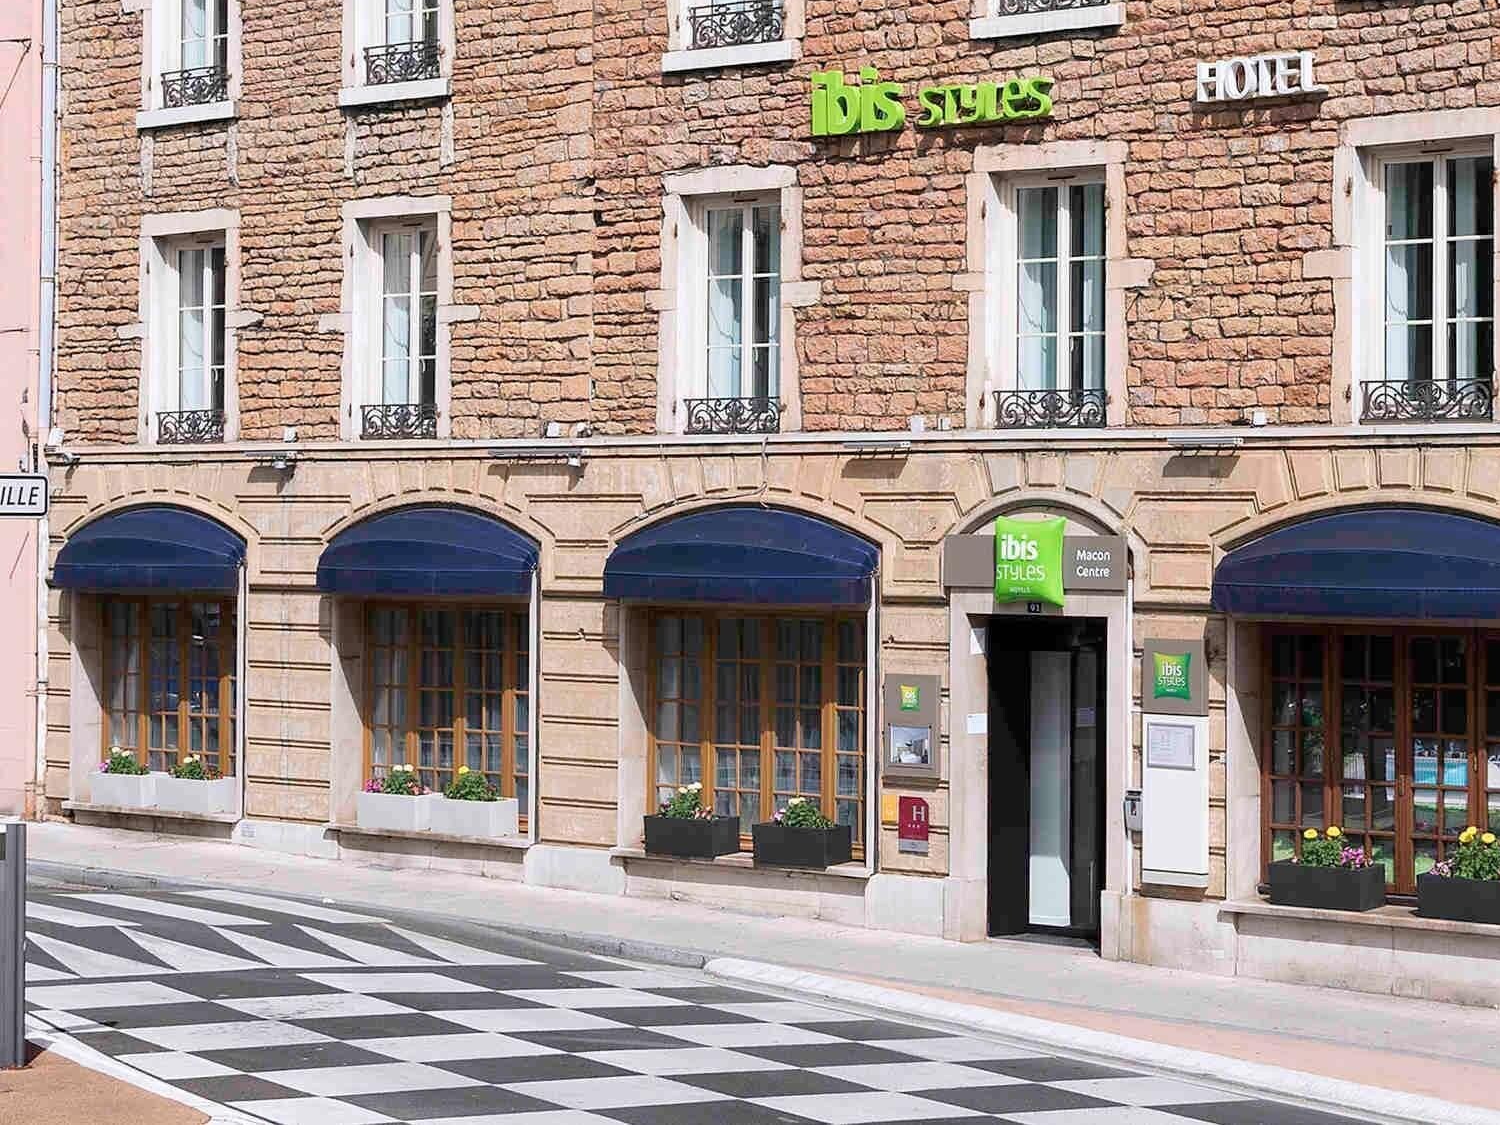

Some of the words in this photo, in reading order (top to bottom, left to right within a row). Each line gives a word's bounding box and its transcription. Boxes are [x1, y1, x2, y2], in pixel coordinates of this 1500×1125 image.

[1196, 50, 1328, 102] HOTEL
[811, 66, 905, 135] ibis
[1001, 534, 1039, 561] ibis
[1076, 549, 1111, 561] Macon
[1076, 566, 1110, 578] Centre
[1162, 661, 1183, 676] ibis
